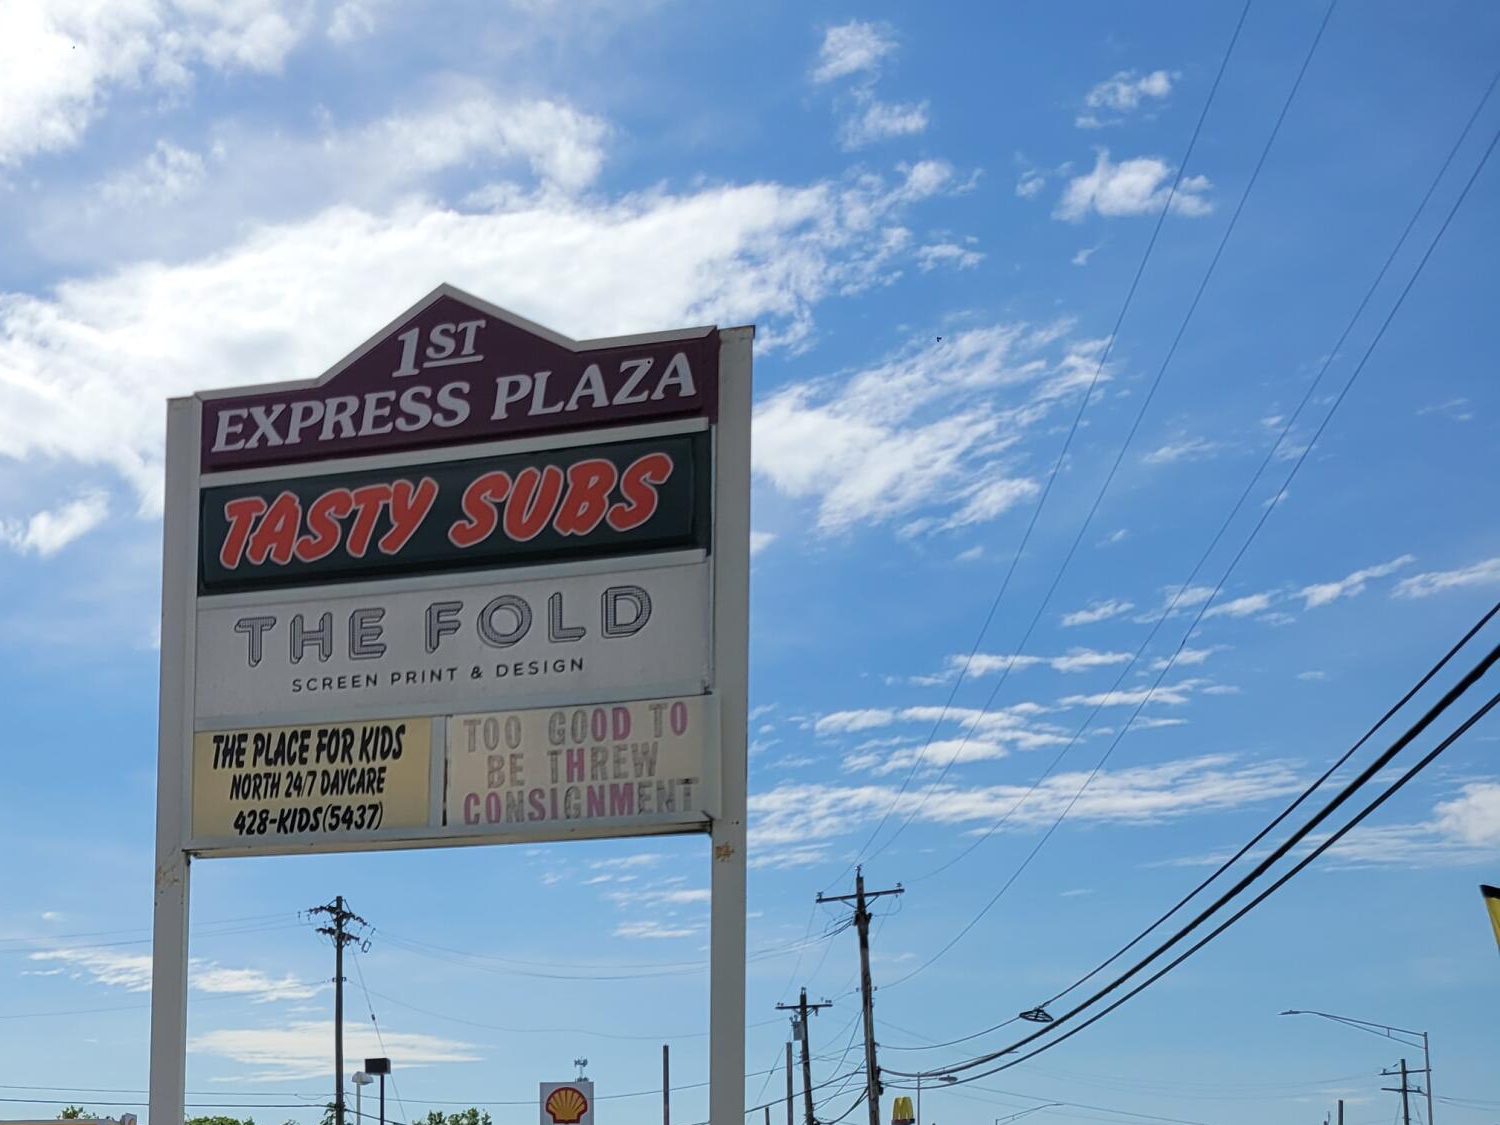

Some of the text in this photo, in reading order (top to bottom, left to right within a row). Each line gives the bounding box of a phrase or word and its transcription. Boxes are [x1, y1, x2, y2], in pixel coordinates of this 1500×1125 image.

[391, 319, 486, 378] 1ST
[211, 352, 697, 453] EXPRESS PLAZA
[219, 453, 673, 569] TASTY SUBS
[234, 585, 652, 667] THE FOLD
[291, 657, 584, 692] SCREEN PRINT & DESIGN
[212, 724, 405, 769] THE PLACE FOR KIDS
[463, 701, 688, 753] TOO GOOD TO
[229, 766, 387, 802] NORTH 24/7 DAYCARE
[487, 741, 658, 789] BE THREW
[233, 800, 384, 836] 428-KIDS(5437)
[463, 777, 699, 826] CONSIGNMENT
